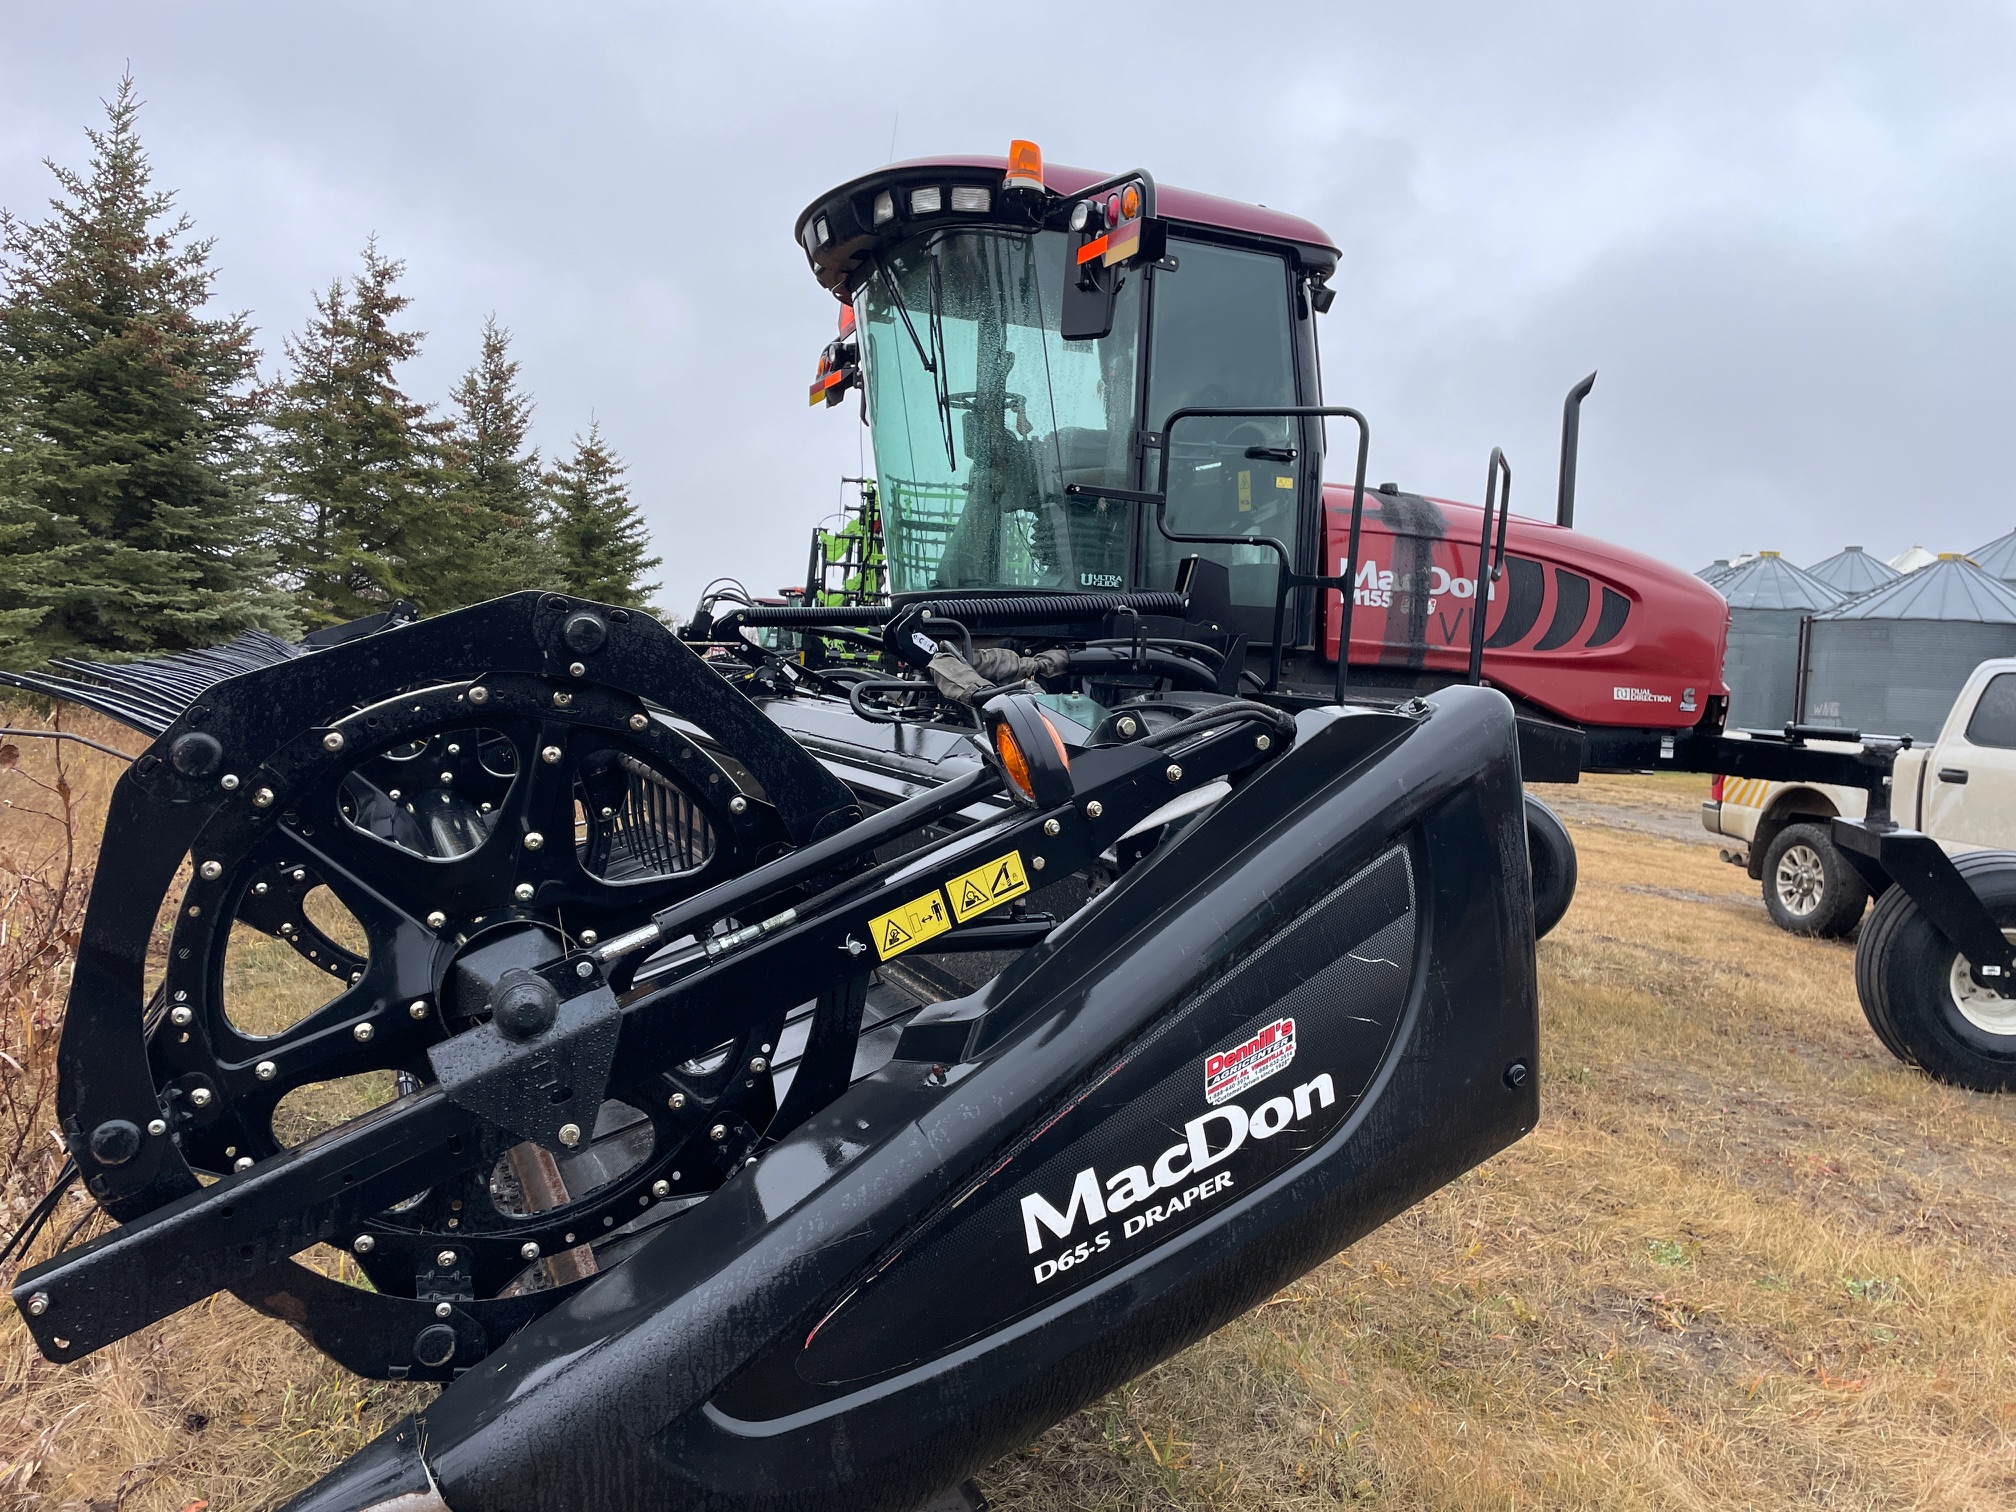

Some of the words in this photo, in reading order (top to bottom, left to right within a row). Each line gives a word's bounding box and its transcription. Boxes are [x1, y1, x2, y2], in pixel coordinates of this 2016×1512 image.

[1093, 574, 1122, 582] ULTRA
[1631, 694, 1672, 703] DIRECTION
[1207, 1020, 1293, 1079] Dennill's
[1211, 1037, 1289, 1085] AGRICENTER
[1020, 1073, 1335, 1254] MacDon
[1033, 1231, 1111, 1285] D65-S
[1123, 1171, 1235, 1239] DRAPER
